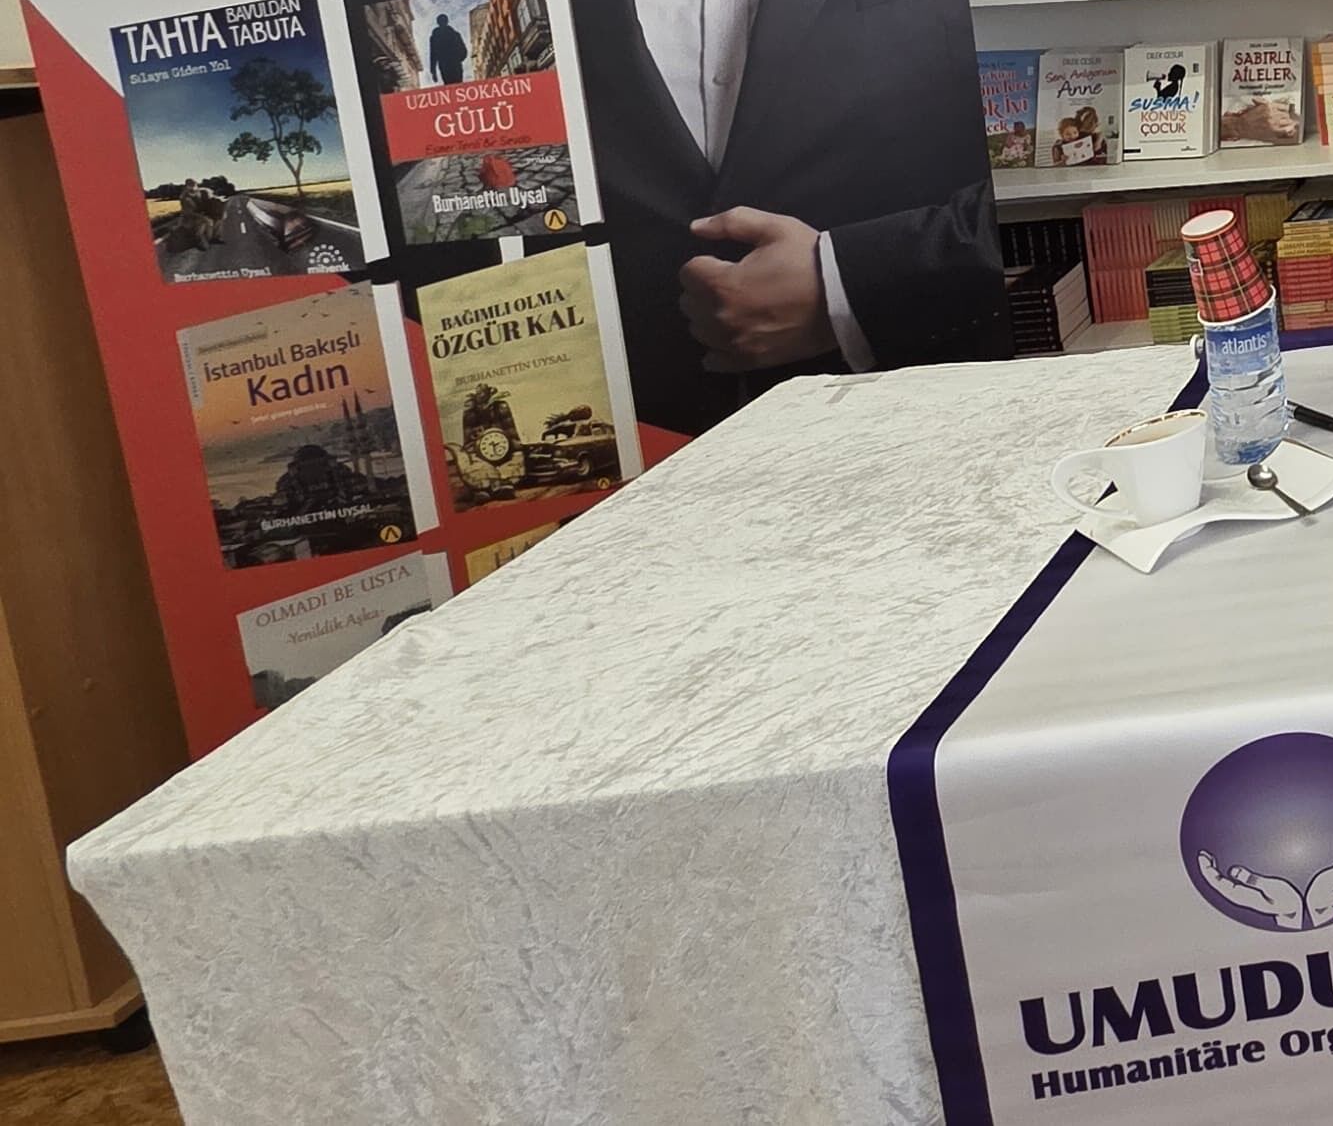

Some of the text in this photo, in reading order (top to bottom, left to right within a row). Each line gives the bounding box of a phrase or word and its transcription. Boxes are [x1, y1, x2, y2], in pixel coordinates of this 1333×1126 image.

[120, 12, 228, 65] TAHTA
[228, 16, 306, 47] TABUTA
[171, 60, 232, 79] Giden Yol
[1234, 50, 1291, 66] SABIRLI
[1056, 80, 1104, 99] Anne
[1232, 66, 1292, 83] AİLELER
[405, 78, 532, 111] UZUN SOKAĞIN
[1128, 91, 1200, 113] SUSMA!
[434, 101, 515, 139] GÜLÜ
[1139, 123, 1187, 137] ÇOCUK
[431, 185, 548, 214] Burhanettin Uysal
[441, 288, 565, 332] BAĞIMLI OLMA
[431, 305, 585, 359] ÖZGÜR KAL
[1222, 333, 1268, 354] atlantis
[203, 347, 286, 382] İstanbul
[290, 330, 360, 361] Bakışlı
[532, 353, 571, 370] UYSAL
[247, 363, 349, 407] Kadın
[337, 502, 374, 520] UYSAL
[255, 565, 412, 628] OLMADI BE USTA
[1031, 1038, 1266, 1099] Humanitäre
